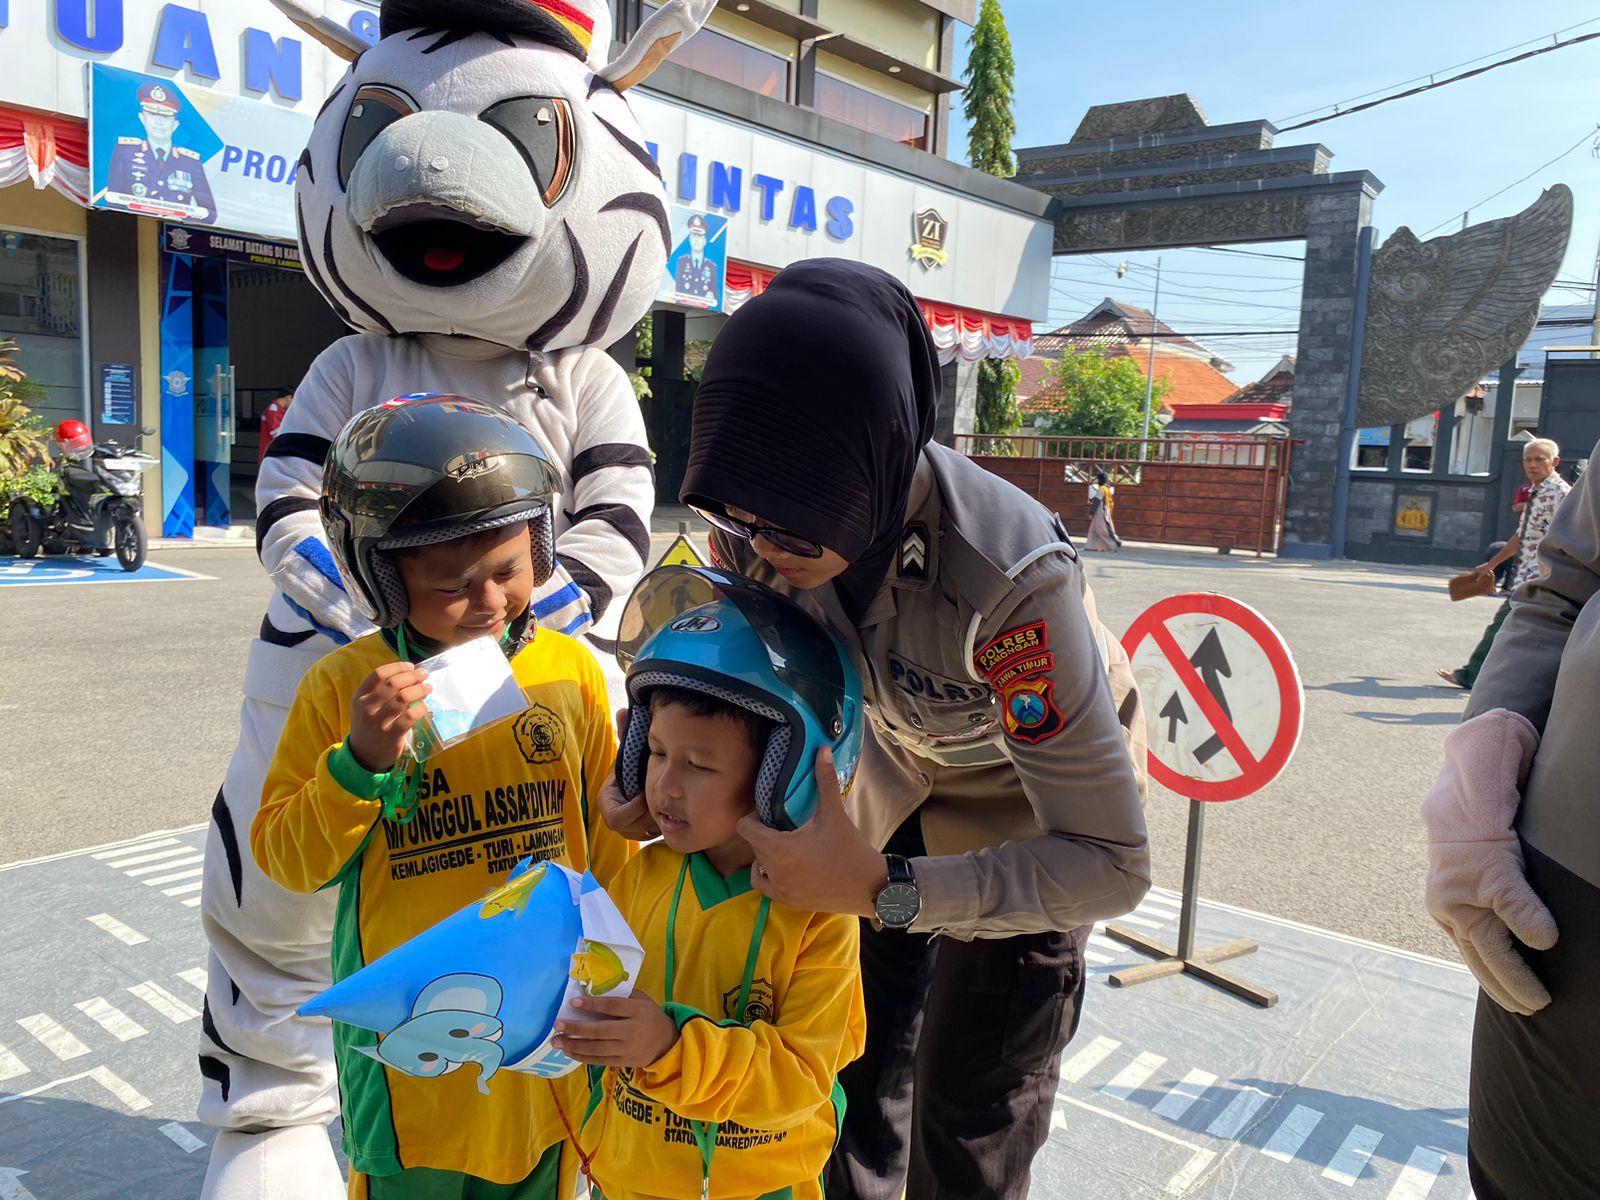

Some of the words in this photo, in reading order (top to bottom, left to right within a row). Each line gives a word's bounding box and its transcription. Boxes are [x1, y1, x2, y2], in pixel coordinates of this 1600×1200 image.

[0, 0, 302, 101] UAN
[644, 140, 854, 239] INTAS
[209, 235, 244, 252] SELAMAT
[245, 241, 273, 257] DATANG
[274, 246, 283, 258] DI
[921, 219, 942, 241] ZI
[980, 629, 1037, 666] POLRES
[985, 638, 1039, 671] LAMONGAN
[997, 669, 1017, 688] JAWA
[1016, 657, 1048, 673] TIMUR
[485, 779, 567, 828] ASSA'DIYAH
[391, 846, 475, 881] KEMLAGIGEDE
[483, 837, 515, 859] TURI
[522, 827, 565, 852] LAMONGAN
[664, 1127, 698, 1147] STATUS
